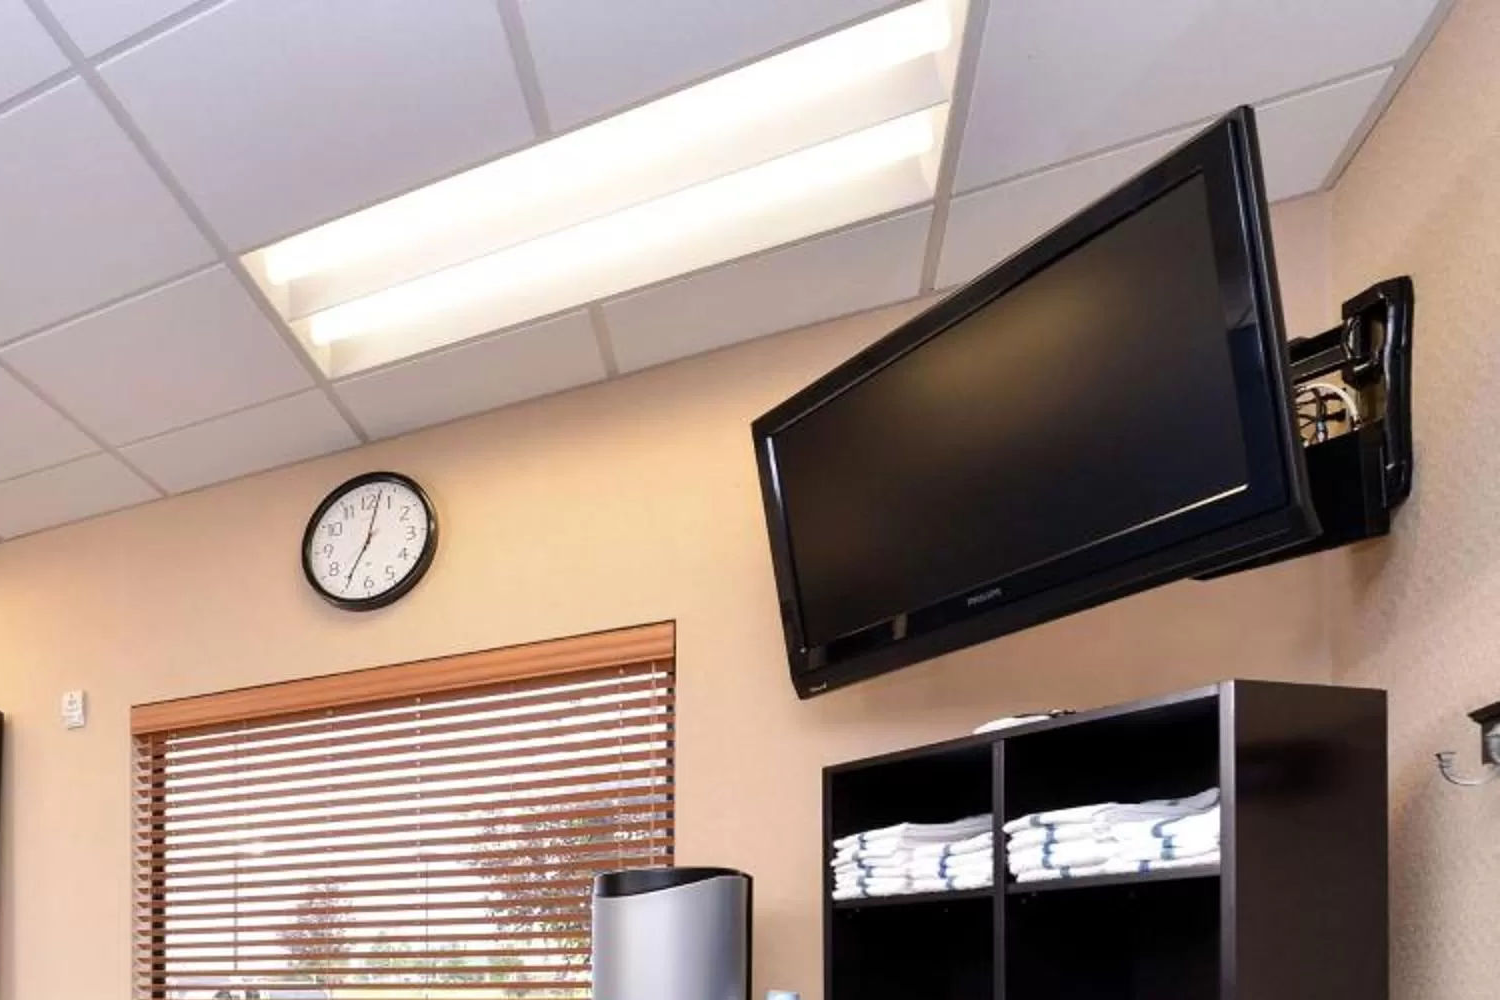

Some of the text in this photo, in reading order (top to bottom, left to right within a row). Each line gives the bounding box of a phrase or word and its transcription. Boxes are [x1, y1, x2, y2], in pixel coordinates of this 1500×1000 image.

[400, 506, 410, 521] 2
[405, 526, 416, 541] 3
[324, 544, 333, 558] 9
[399, 547, 408, 560] 4
[330, 562, 339, 577] 8
[385, 566, 395, 580] 5
[364, 576, 374, 588] 6
